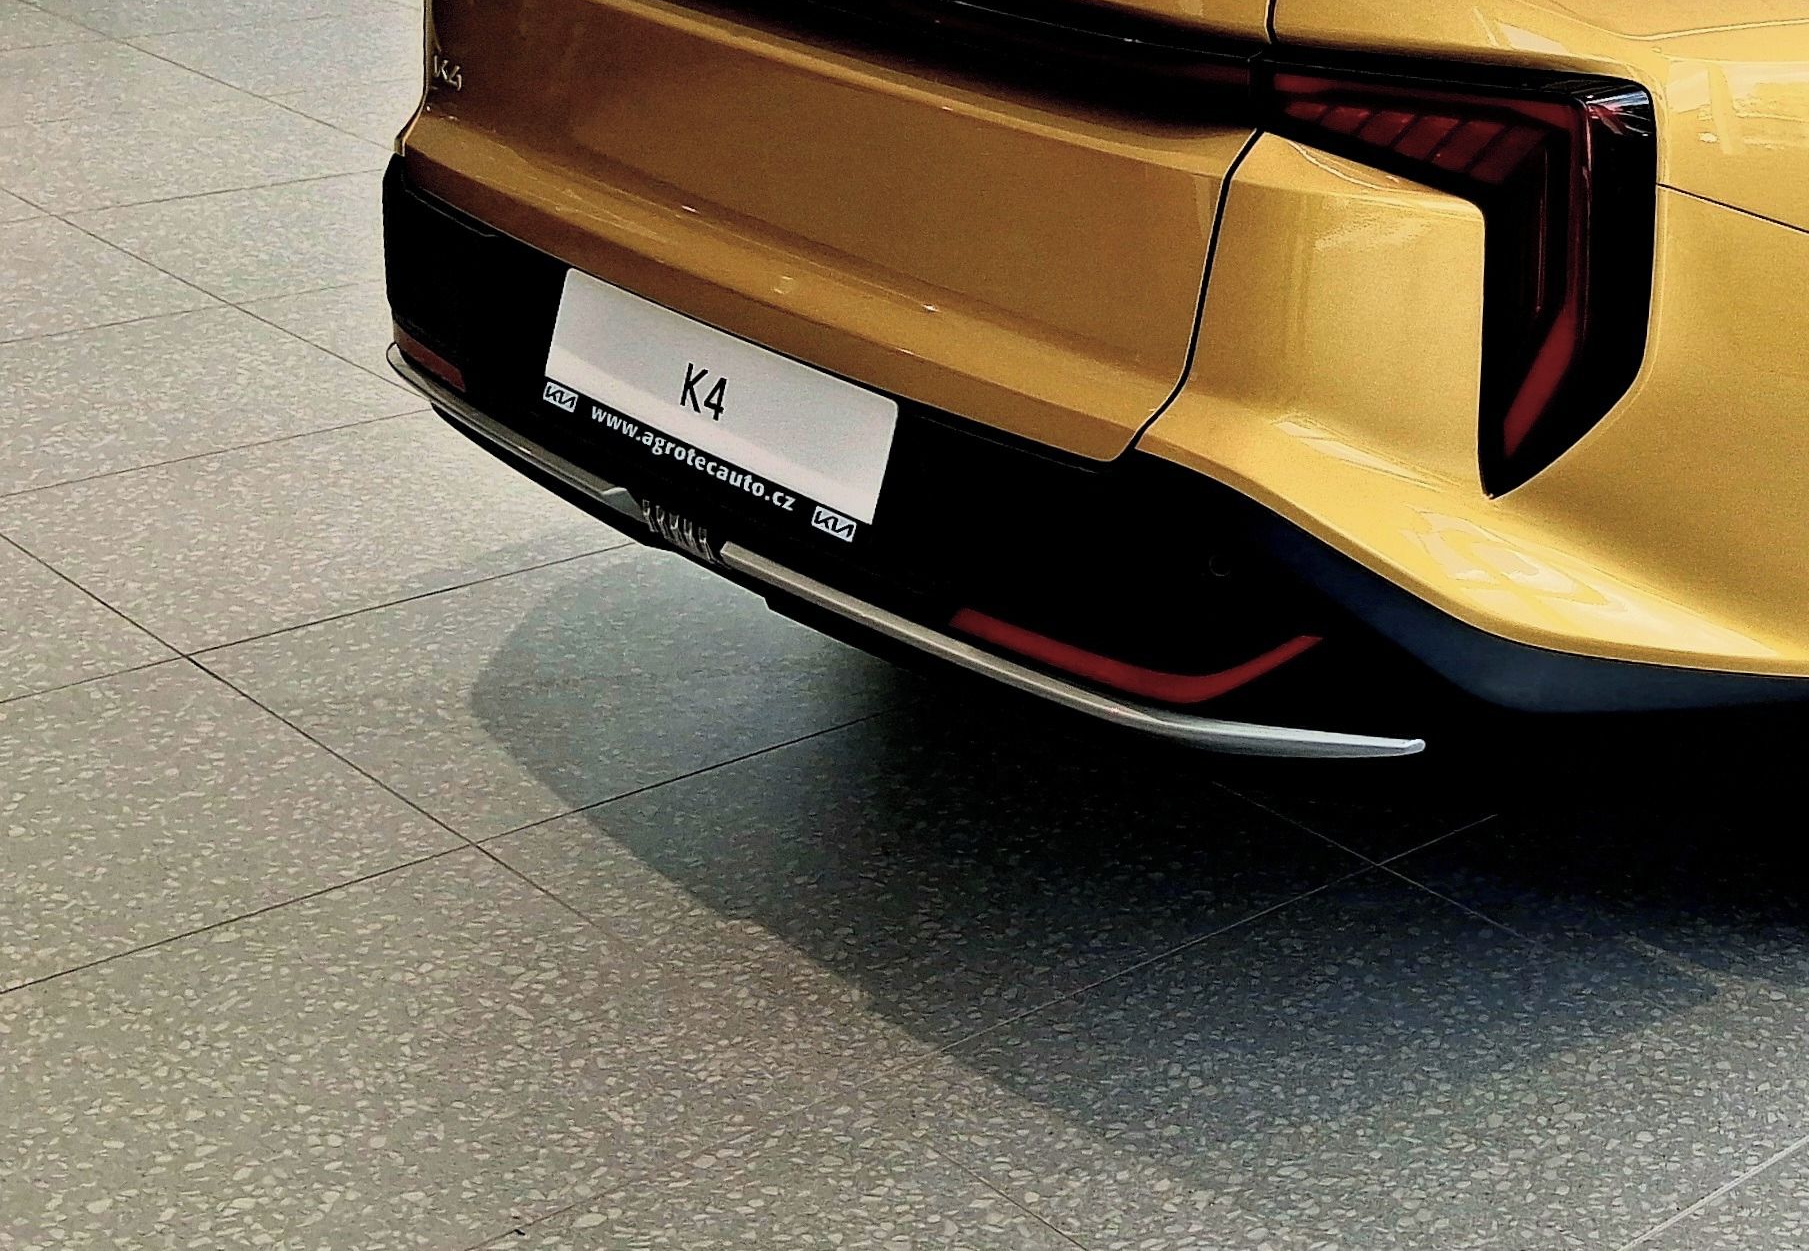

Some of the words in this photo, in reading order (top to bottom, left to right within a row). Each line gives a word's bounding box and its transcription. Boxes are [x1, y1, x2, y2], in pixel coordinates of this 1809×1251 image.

[433, 55, 462, 91] K4
[545, 385, 577, 409] KIA
[680, 362, 728, 422] K4
[590, 405, 797, 512] www.agrotecauto.cz
[813, 510, 855, 538] KIA
